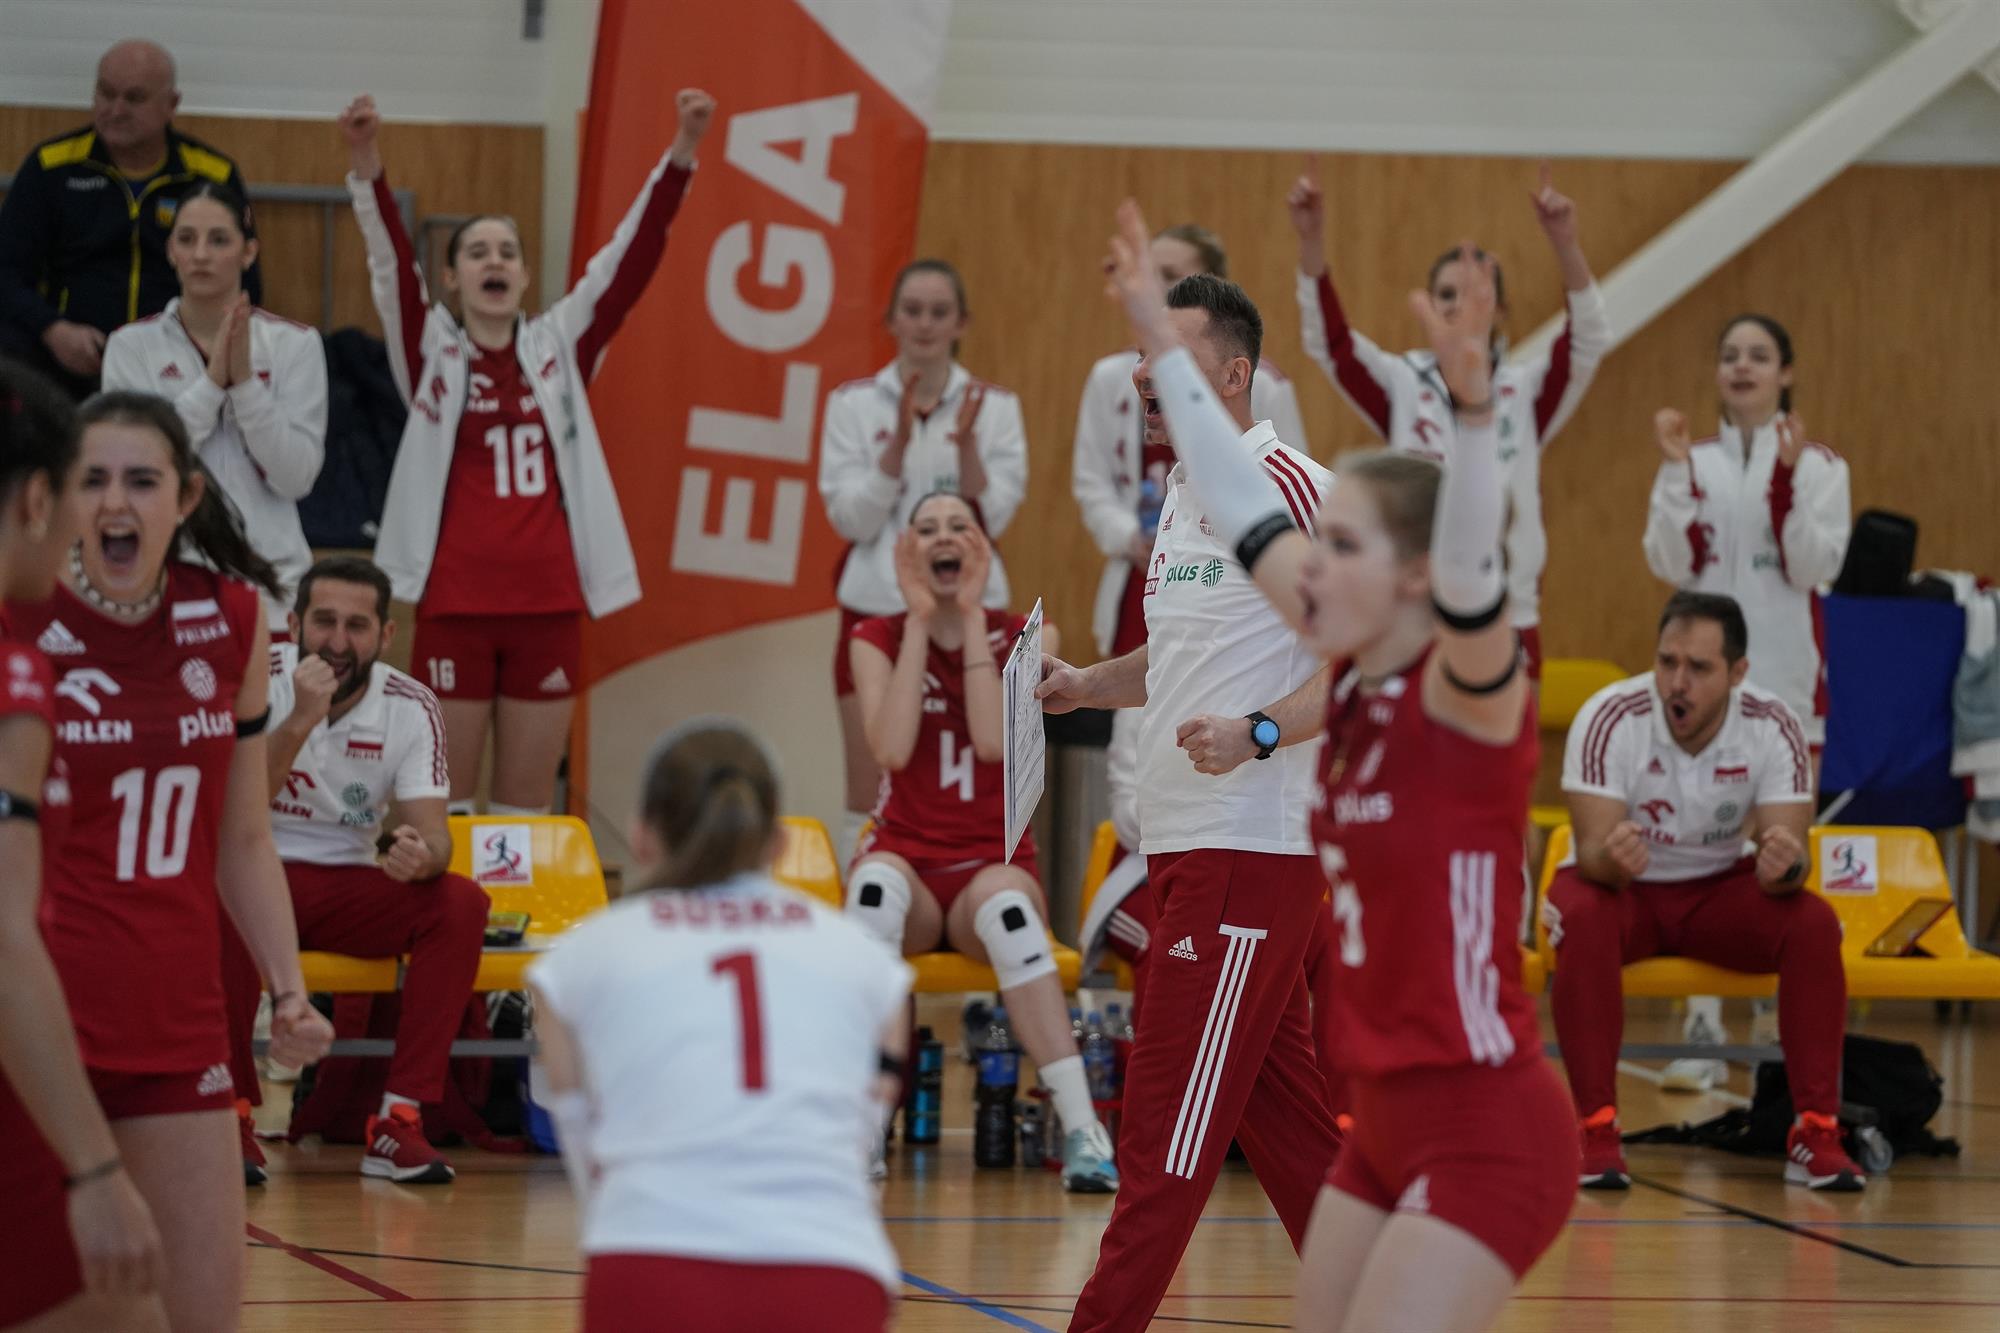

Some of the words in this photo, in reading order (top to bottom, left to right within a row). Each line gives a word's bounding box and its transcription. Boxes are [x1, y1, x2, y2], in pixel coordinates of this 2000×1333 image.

[671, 92, 860, 586] ELGA
[484, 423, 547, 497] 16
[1164, 563, 1200, 588] plus
[178, 706, 235, 747] plus
[939, 729, 975, 802] 4
[111, 764, 202, 882] 10
[1168, 948, 1198, 961] adidas
[709, 950, 767, 1091] 1
